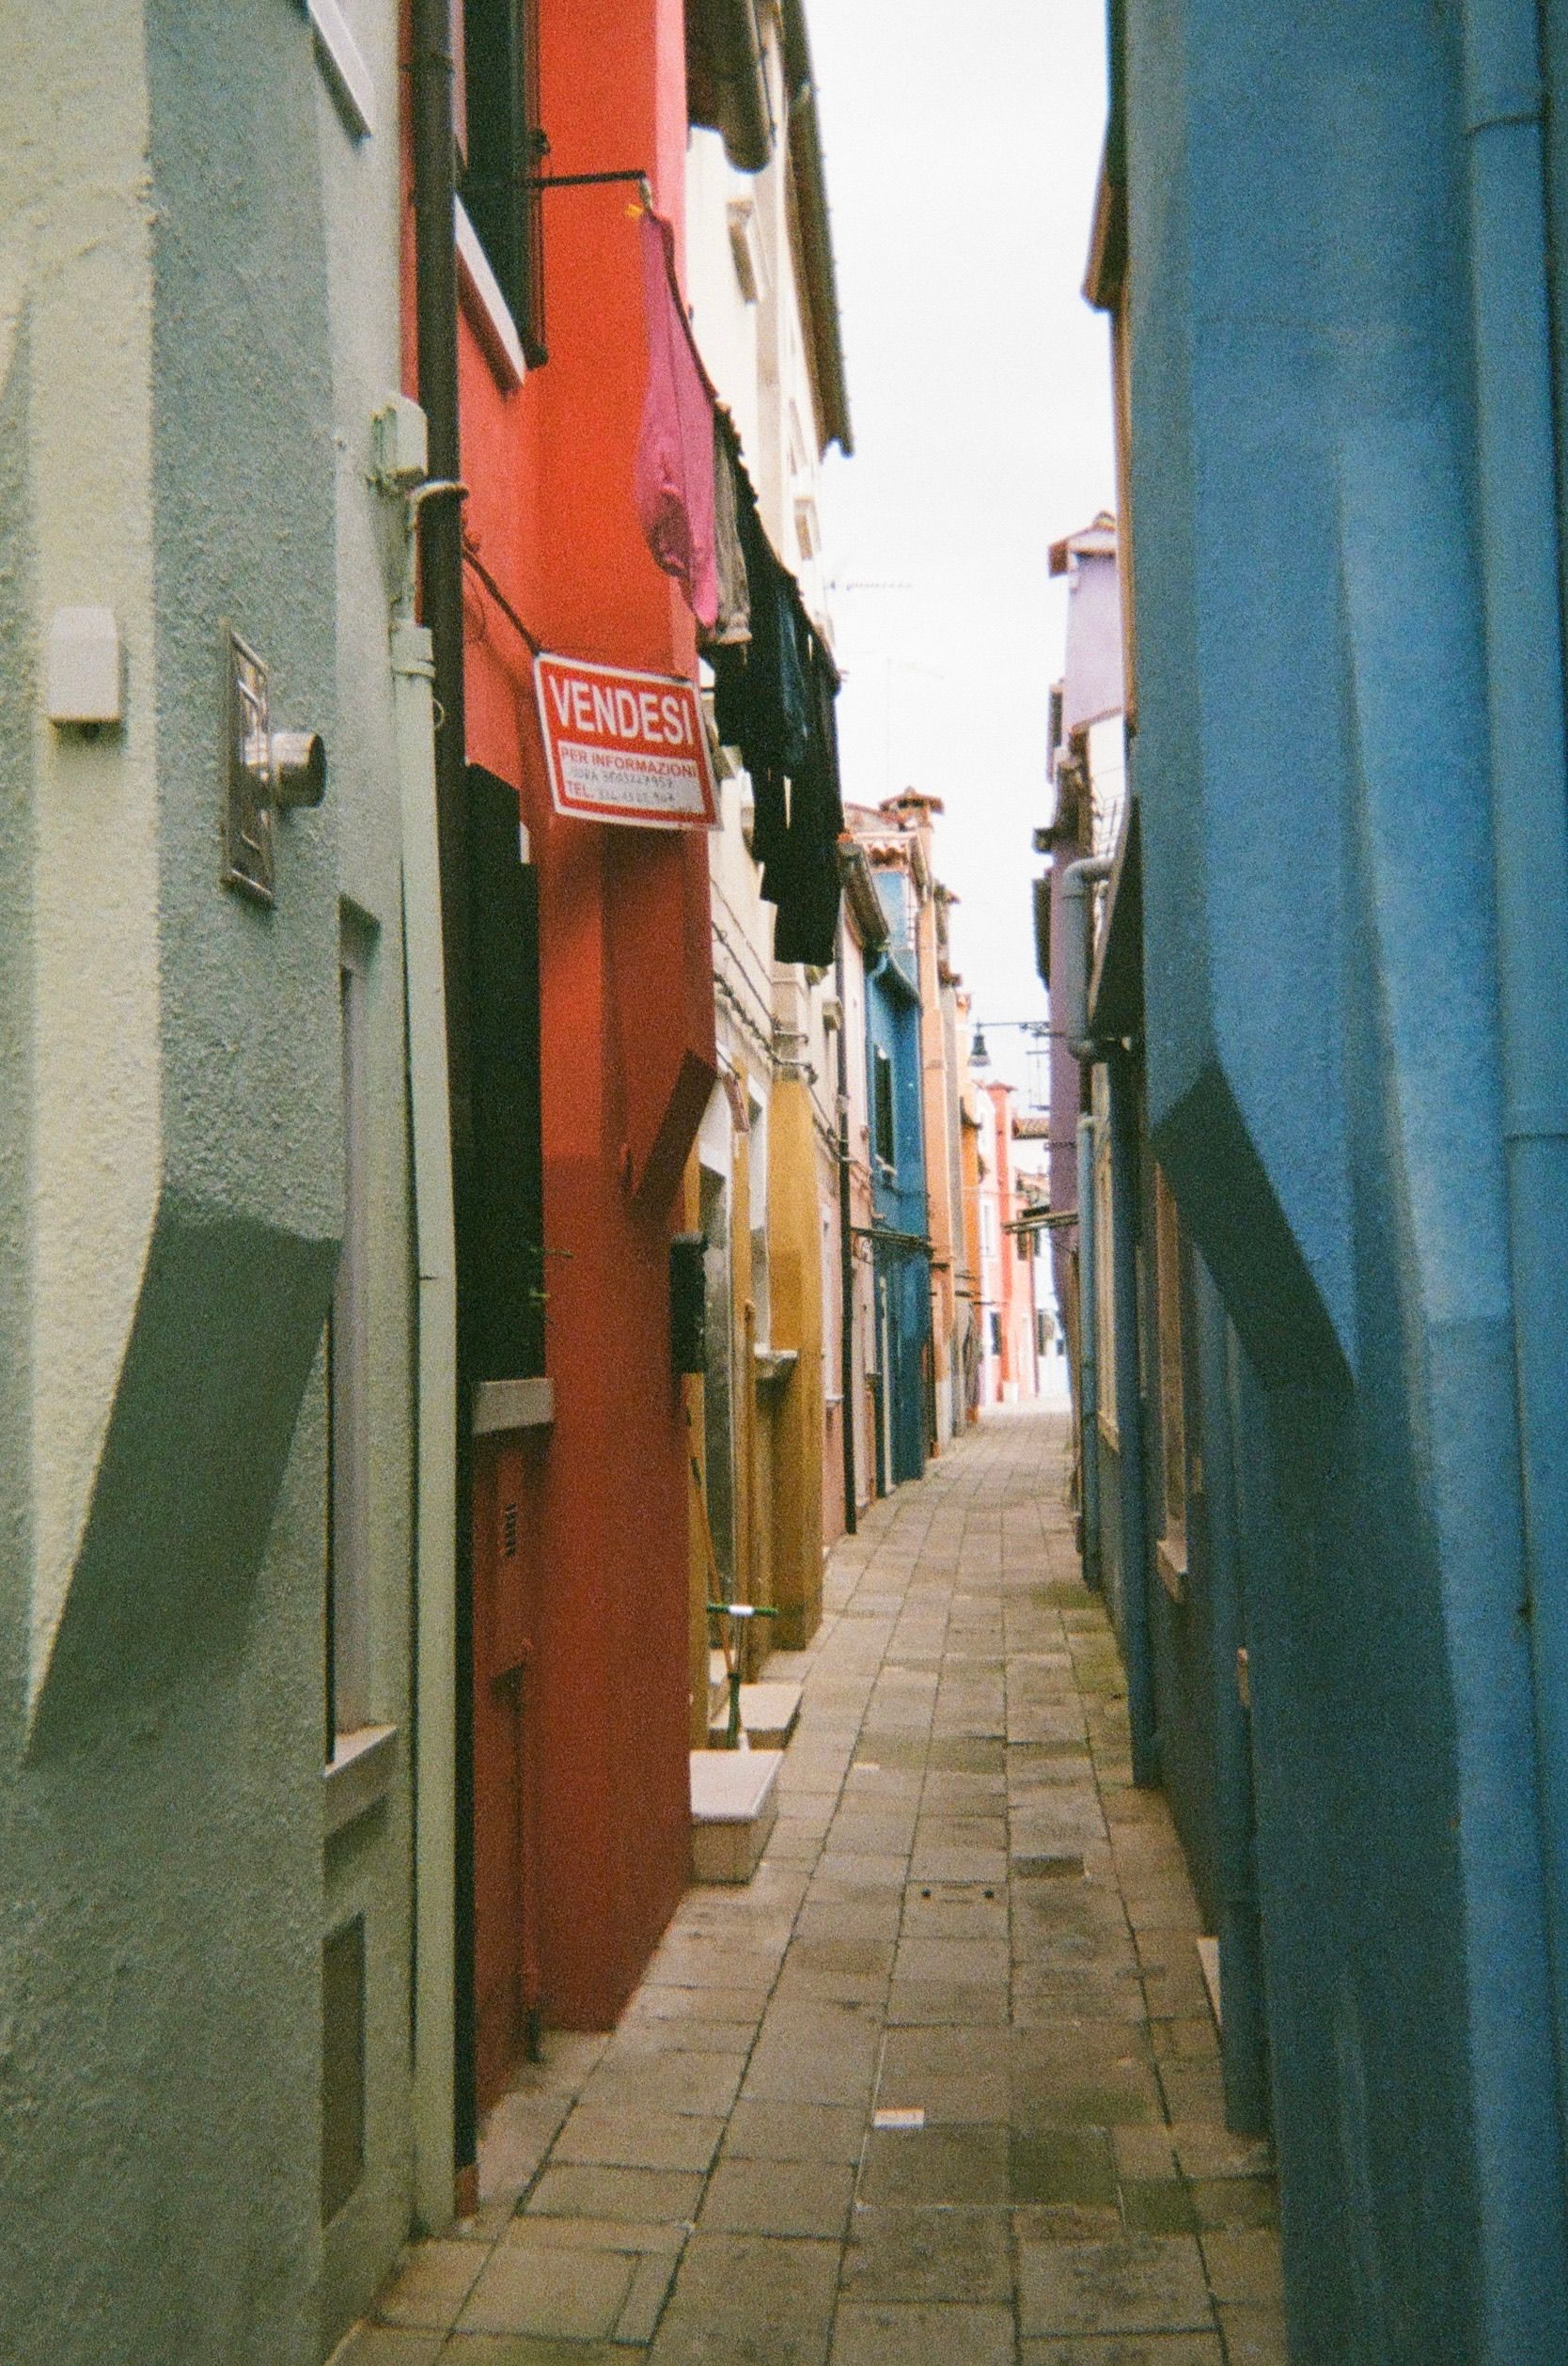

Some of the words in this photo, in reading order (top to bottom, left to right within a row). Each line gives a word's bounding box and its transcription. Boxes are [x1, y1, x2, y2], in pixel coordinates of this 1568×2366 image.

[549, 675, 695, 745] VENDESI
[563, 747, 588, 762] PER
[591, 754, 698, 777] INFORMAZIONI
